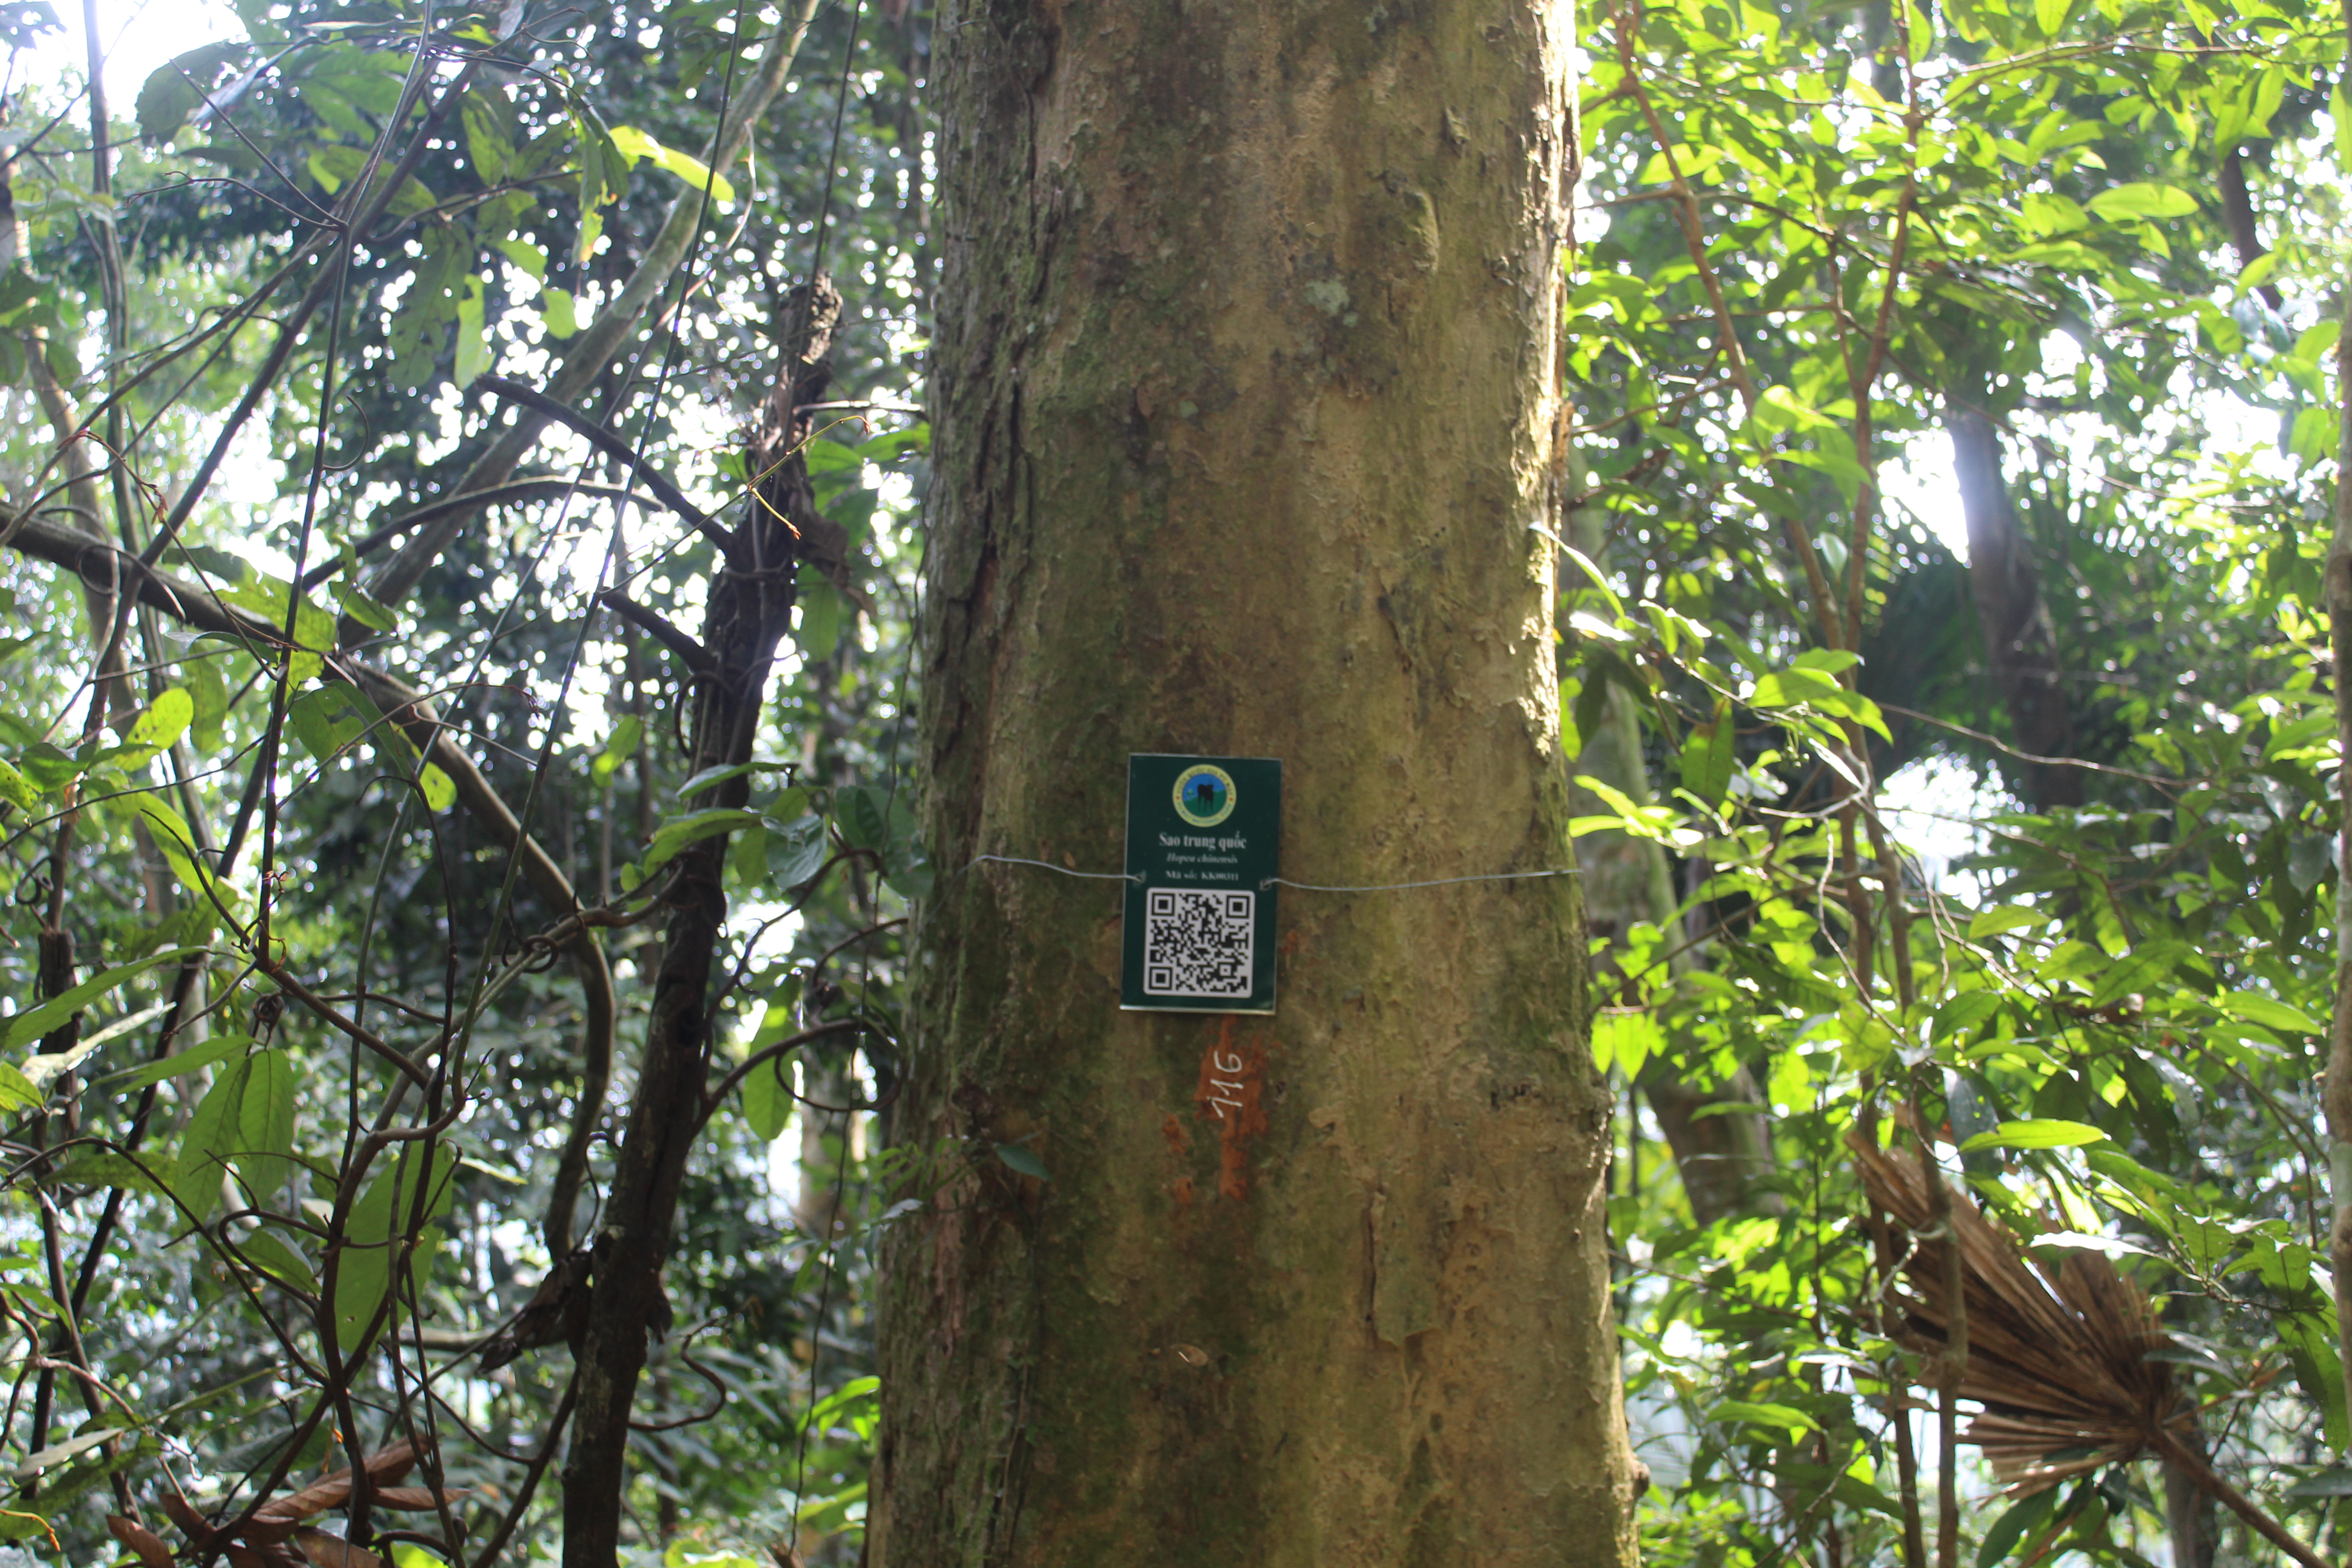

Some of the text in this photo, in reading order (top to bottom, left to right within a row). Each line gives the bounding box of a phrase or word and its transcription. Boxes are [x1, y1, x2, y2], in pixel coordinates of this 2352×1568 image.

[1159, 830, 1247, 852] Sao trung quốc
